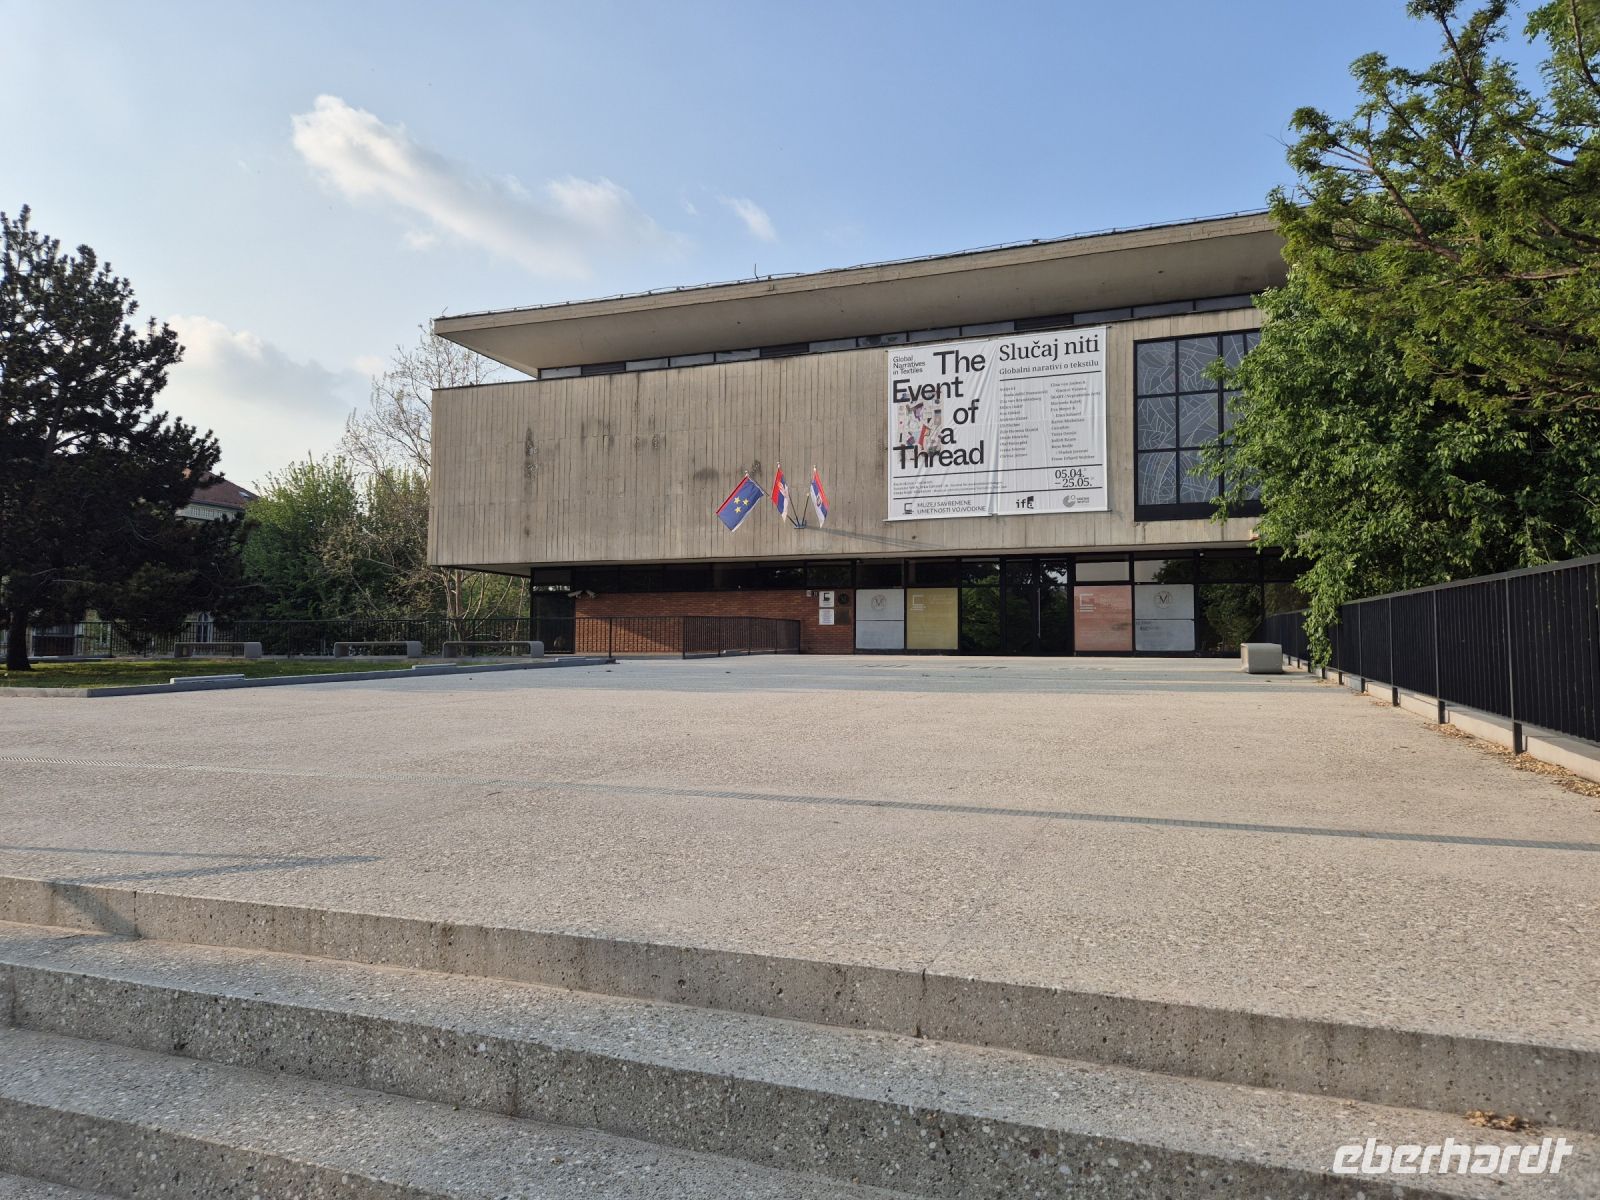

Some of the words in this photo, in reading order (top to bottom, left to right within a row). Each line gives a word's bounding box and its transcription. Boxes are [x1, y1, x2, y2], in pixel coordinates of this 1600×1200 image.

[999, 338, 1058, 361] Slučaj
[1064, 334, 1100, 356] niti
[893, 361, 926, 369] Narratives
[933, 350, 986, 375] The
[999, 365, 1031, 375] Globalni
[1032, 363, 1062, 372] narativi
[1070, 359, 1099, 368] tekstilu
[893, 376, 964, 403] Event
[953, 398, 980, 425] of
[940, 427, 957, 445] a
[893, 440, 985, 470] Thread
